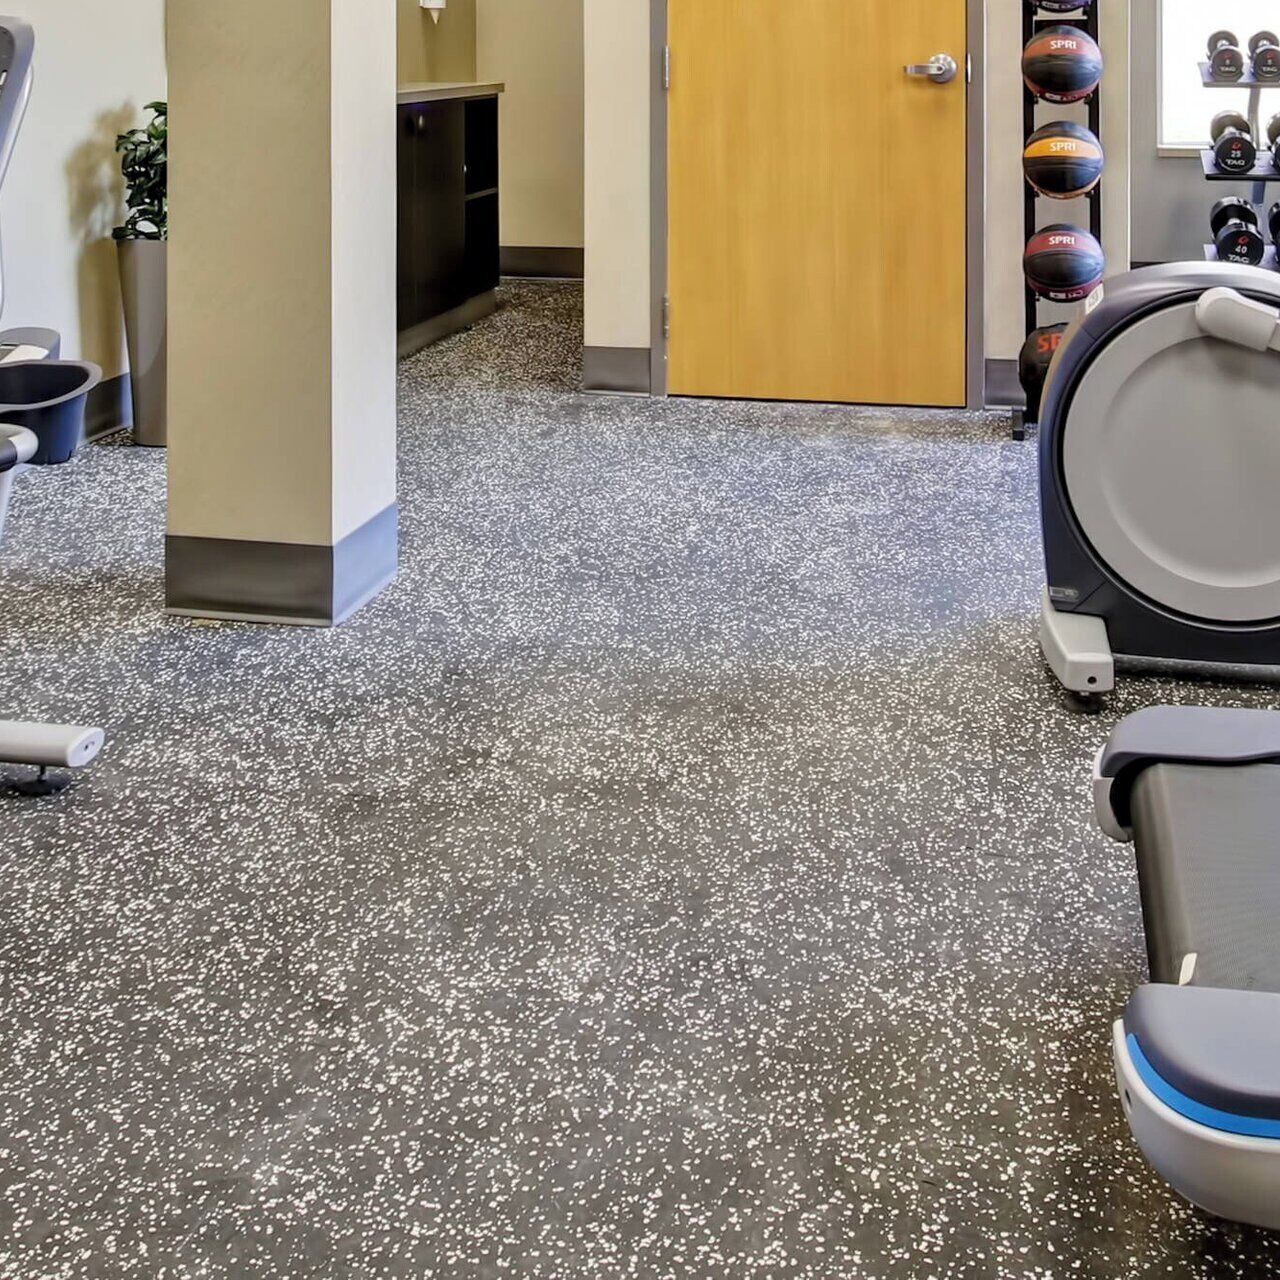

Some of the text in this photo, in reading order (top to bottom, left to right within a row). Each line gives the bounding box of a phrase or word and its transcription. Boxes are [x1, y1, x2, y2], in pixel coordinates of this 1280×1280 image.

[1050, 40, 1077, 49] SPRI
[1049, 142, 1076, 151] SPRI
[1048, 236, 1075, 245] SPRI
[1235, 246, 1247, 254] 40
[1228, 254, 1250, 263] TAG
